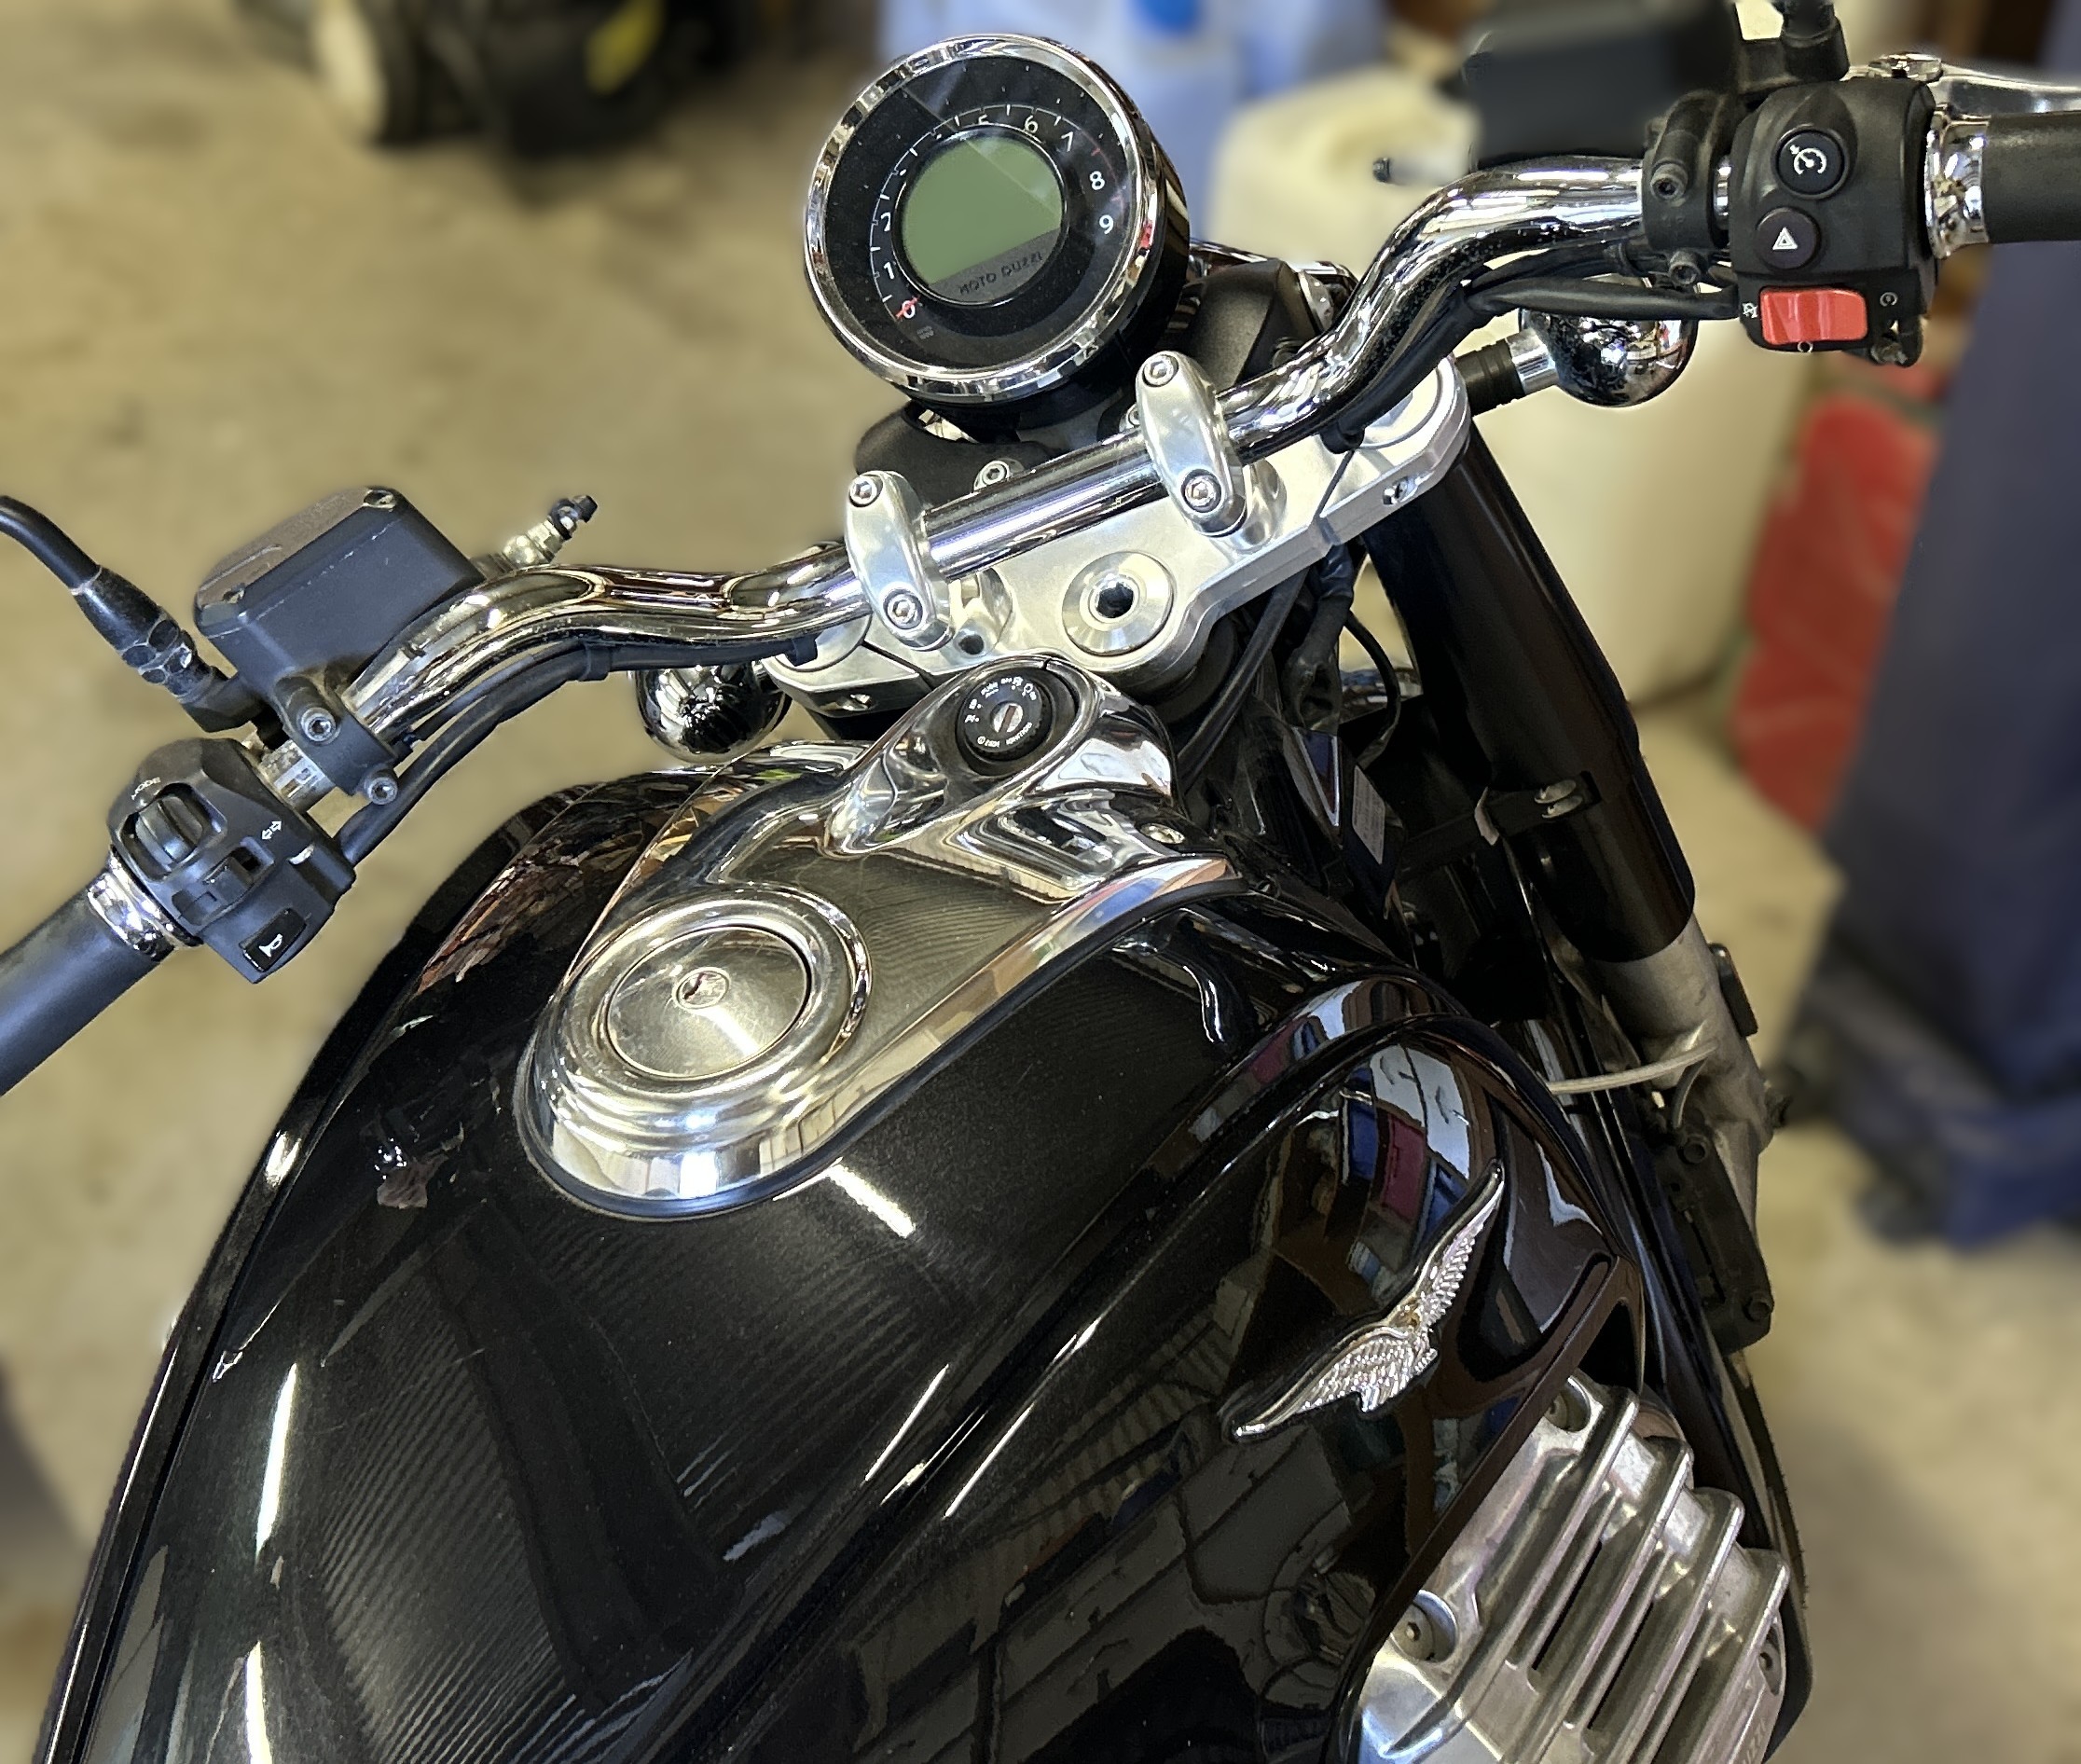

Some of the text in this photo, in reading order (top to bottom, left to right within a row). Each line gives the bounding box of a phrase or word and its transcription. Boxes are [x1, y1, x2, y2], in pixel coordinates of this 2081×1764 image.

[1024, 115, 1039, 134] 6
[1061, 131, 1074, 153] 7
[1089, 171, 1106, 191] 8
[1098, 214, 1114, 235] 9
[883, 261, 895, 280] 1
[959, 272, 997, 296] MOTO
[902, 300, 916, 319] 0
[131, 777, 161, 800] MODE
